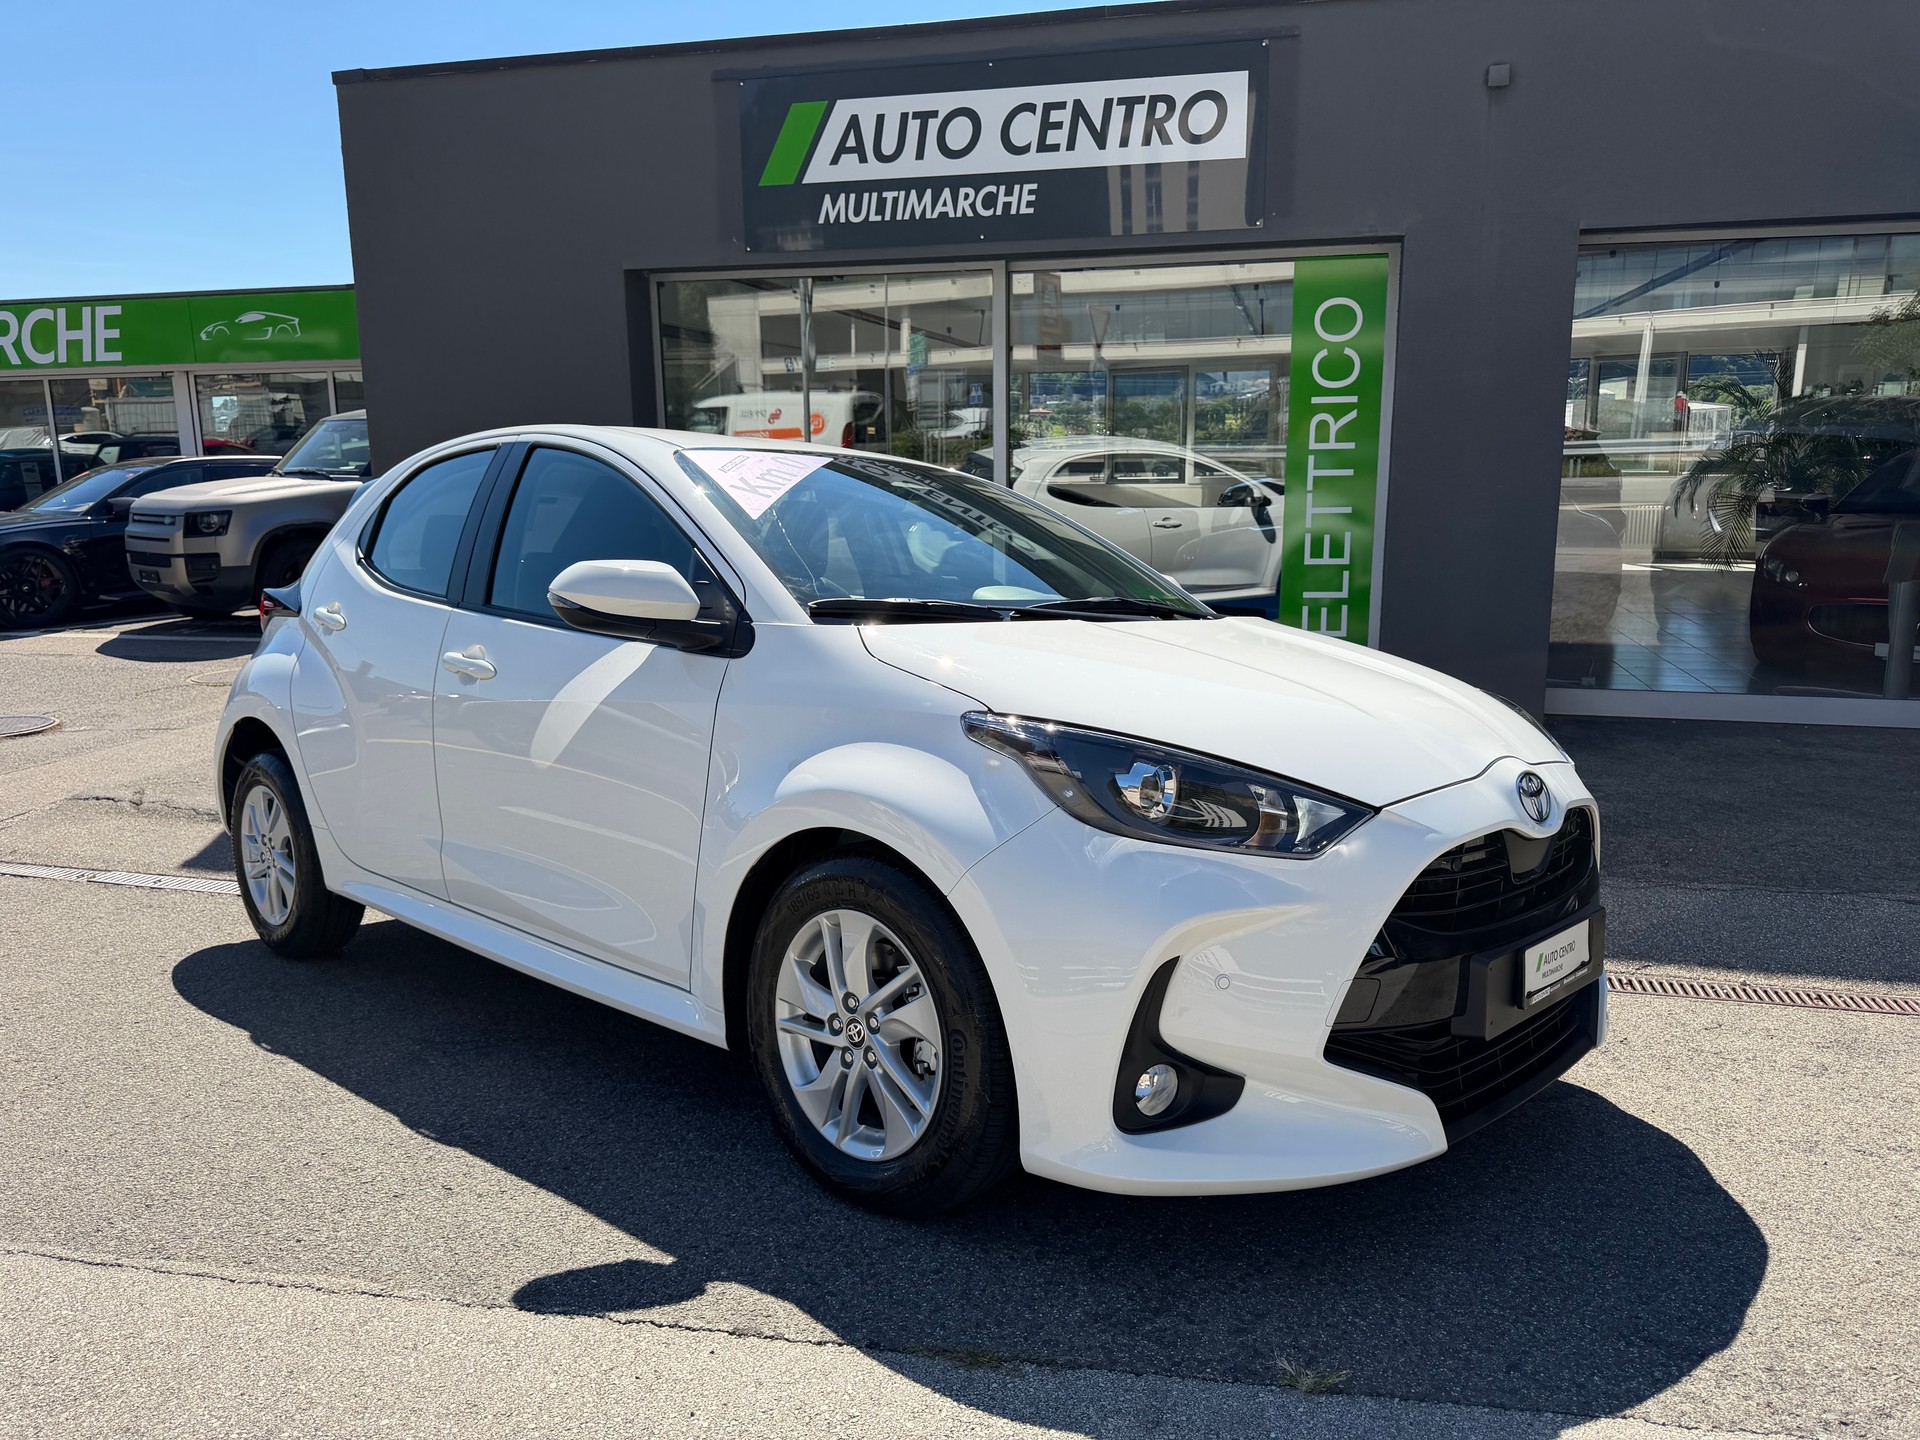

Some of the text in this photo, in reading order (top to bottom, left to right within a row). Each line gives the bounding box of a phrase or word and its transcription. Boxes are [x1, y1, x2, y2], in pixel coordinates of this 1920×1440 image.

[829, 89, 1228, 165] AUTO CENTRO
[818, 183, 1038, 224] MULTIMARCHE
[1301, 296, 1363, 638] ELETTRICO
[1543, 941, 1576, 966] AUTO CENTRO
